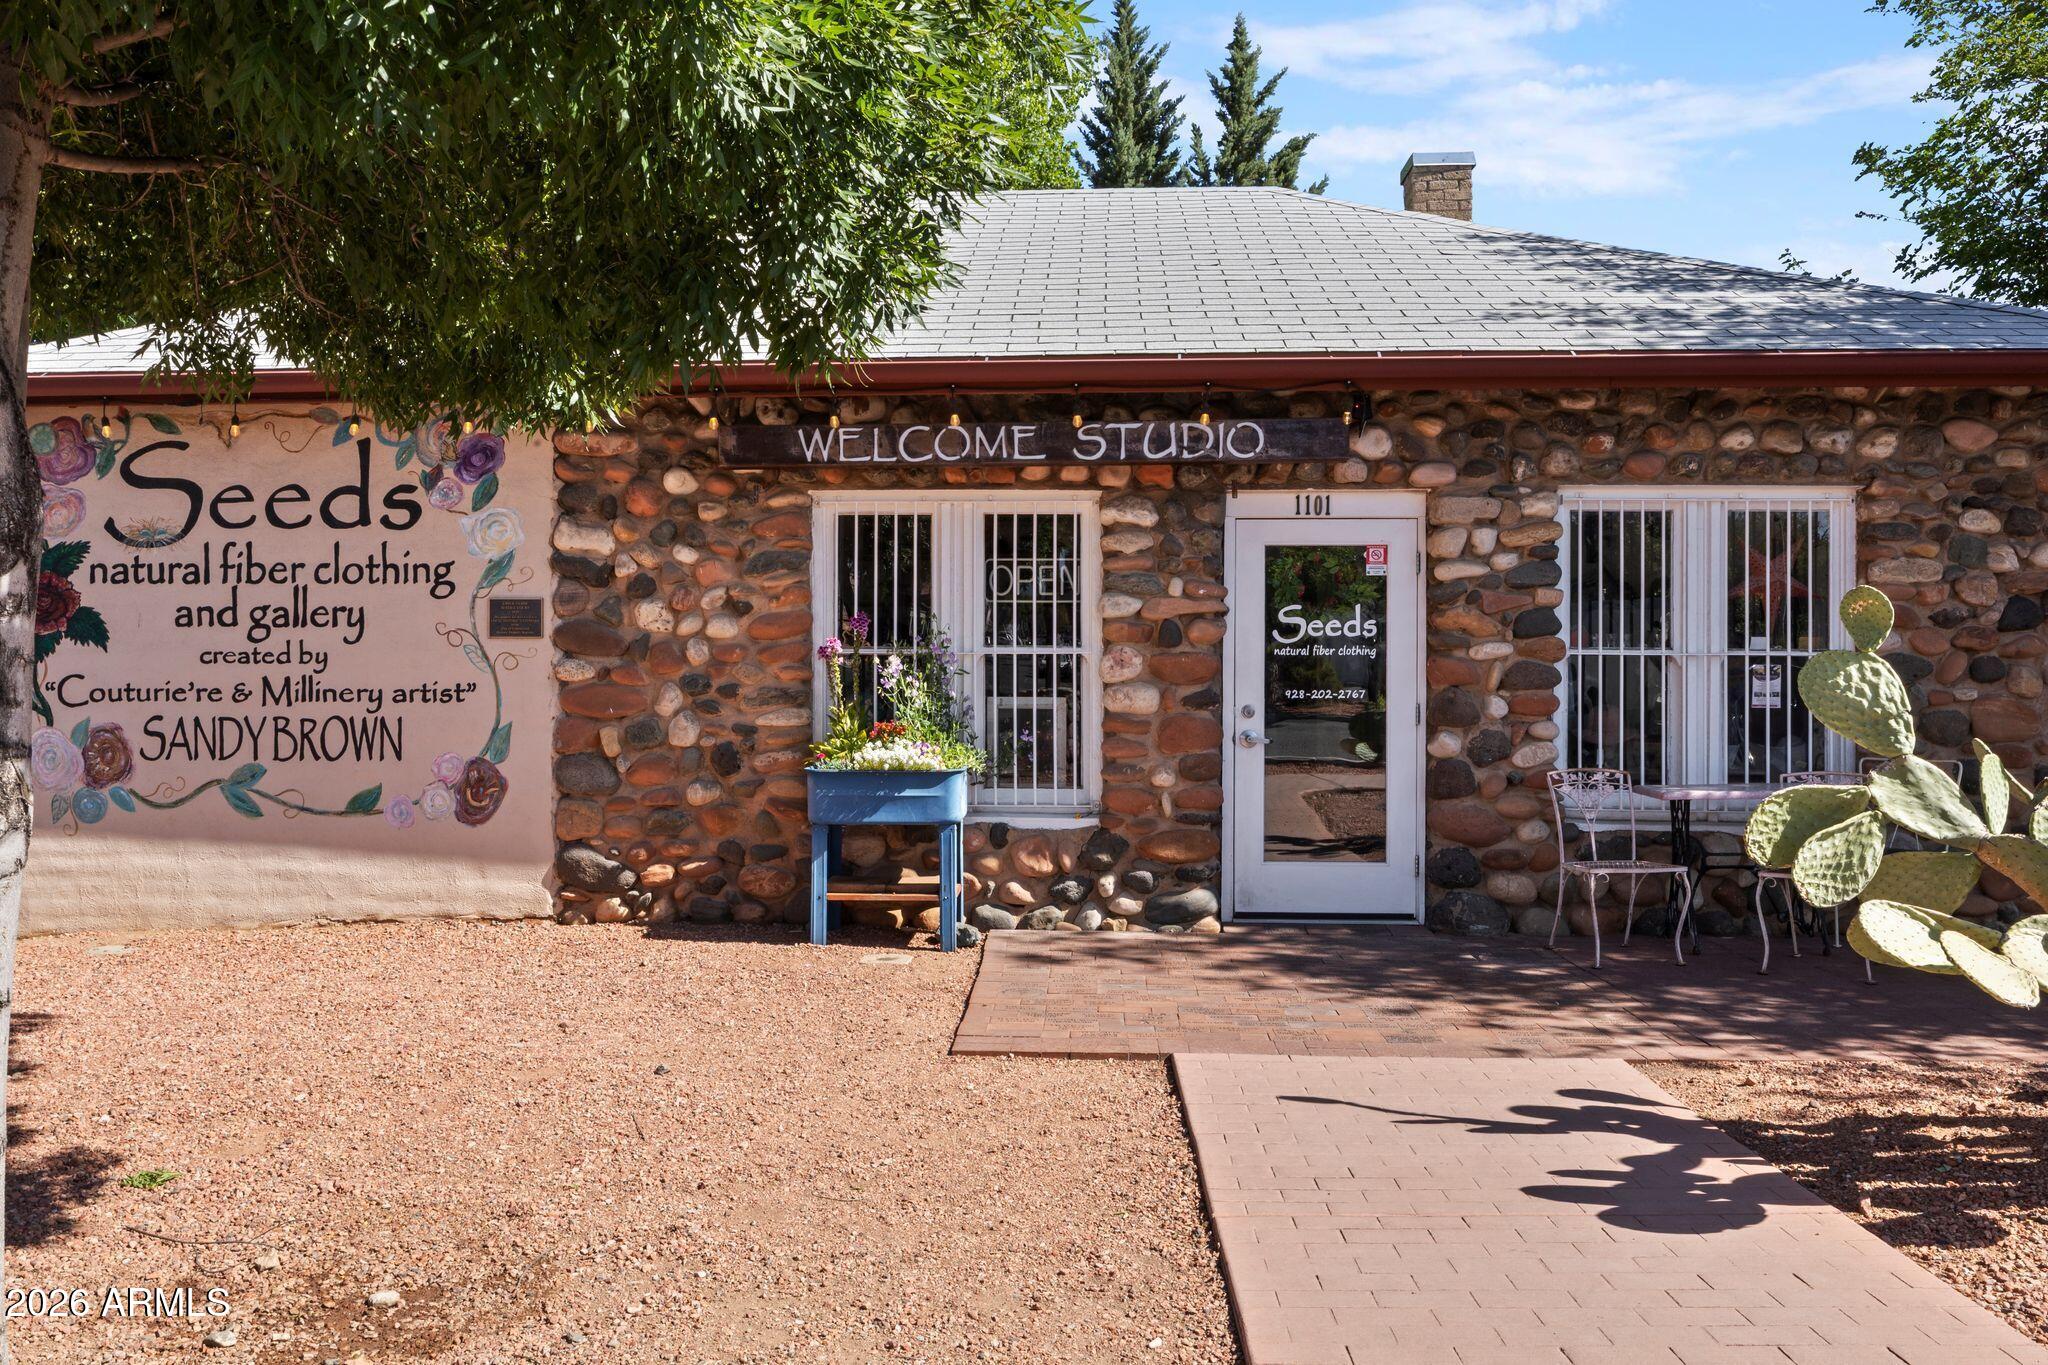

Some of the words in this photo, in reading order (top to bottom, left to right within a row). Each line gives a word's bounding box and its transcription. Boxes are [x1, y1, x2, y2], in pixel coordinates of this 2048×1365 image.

[797, 424, 1047, 463] WELCOME
[1072, 421, 1265, 460] STUDIO
[103, 437, 424, 548] Seeds
[1295, 494, 1331, 516] 1101
[88, 542, 210, 585] natural
[220, 542, 305, 586] fiber
[313, 541, 456, 599] clothing
[989, 564, 1081, 596] OPEN
[174, 588, 239, 628] and
[246, 585, 365, 644] gallery
[1272, 603, 1378, 644] Seeds
[199, 640, 290, 665] created
[299, 639, 328, 674] by
[1274, 645, 1310, 656] natural
[1312, 645, 1336, 657] fiber
[1338, 645, 1377, 659] clothing
[232, 686, 253, 704] &
[261, 676, 383, 714] Millinery
[1285, 689, 1366, 699] 928-202-2767
[139, 715, 271, 761] SANDY
[273, 716, 403, 761] BROWN
